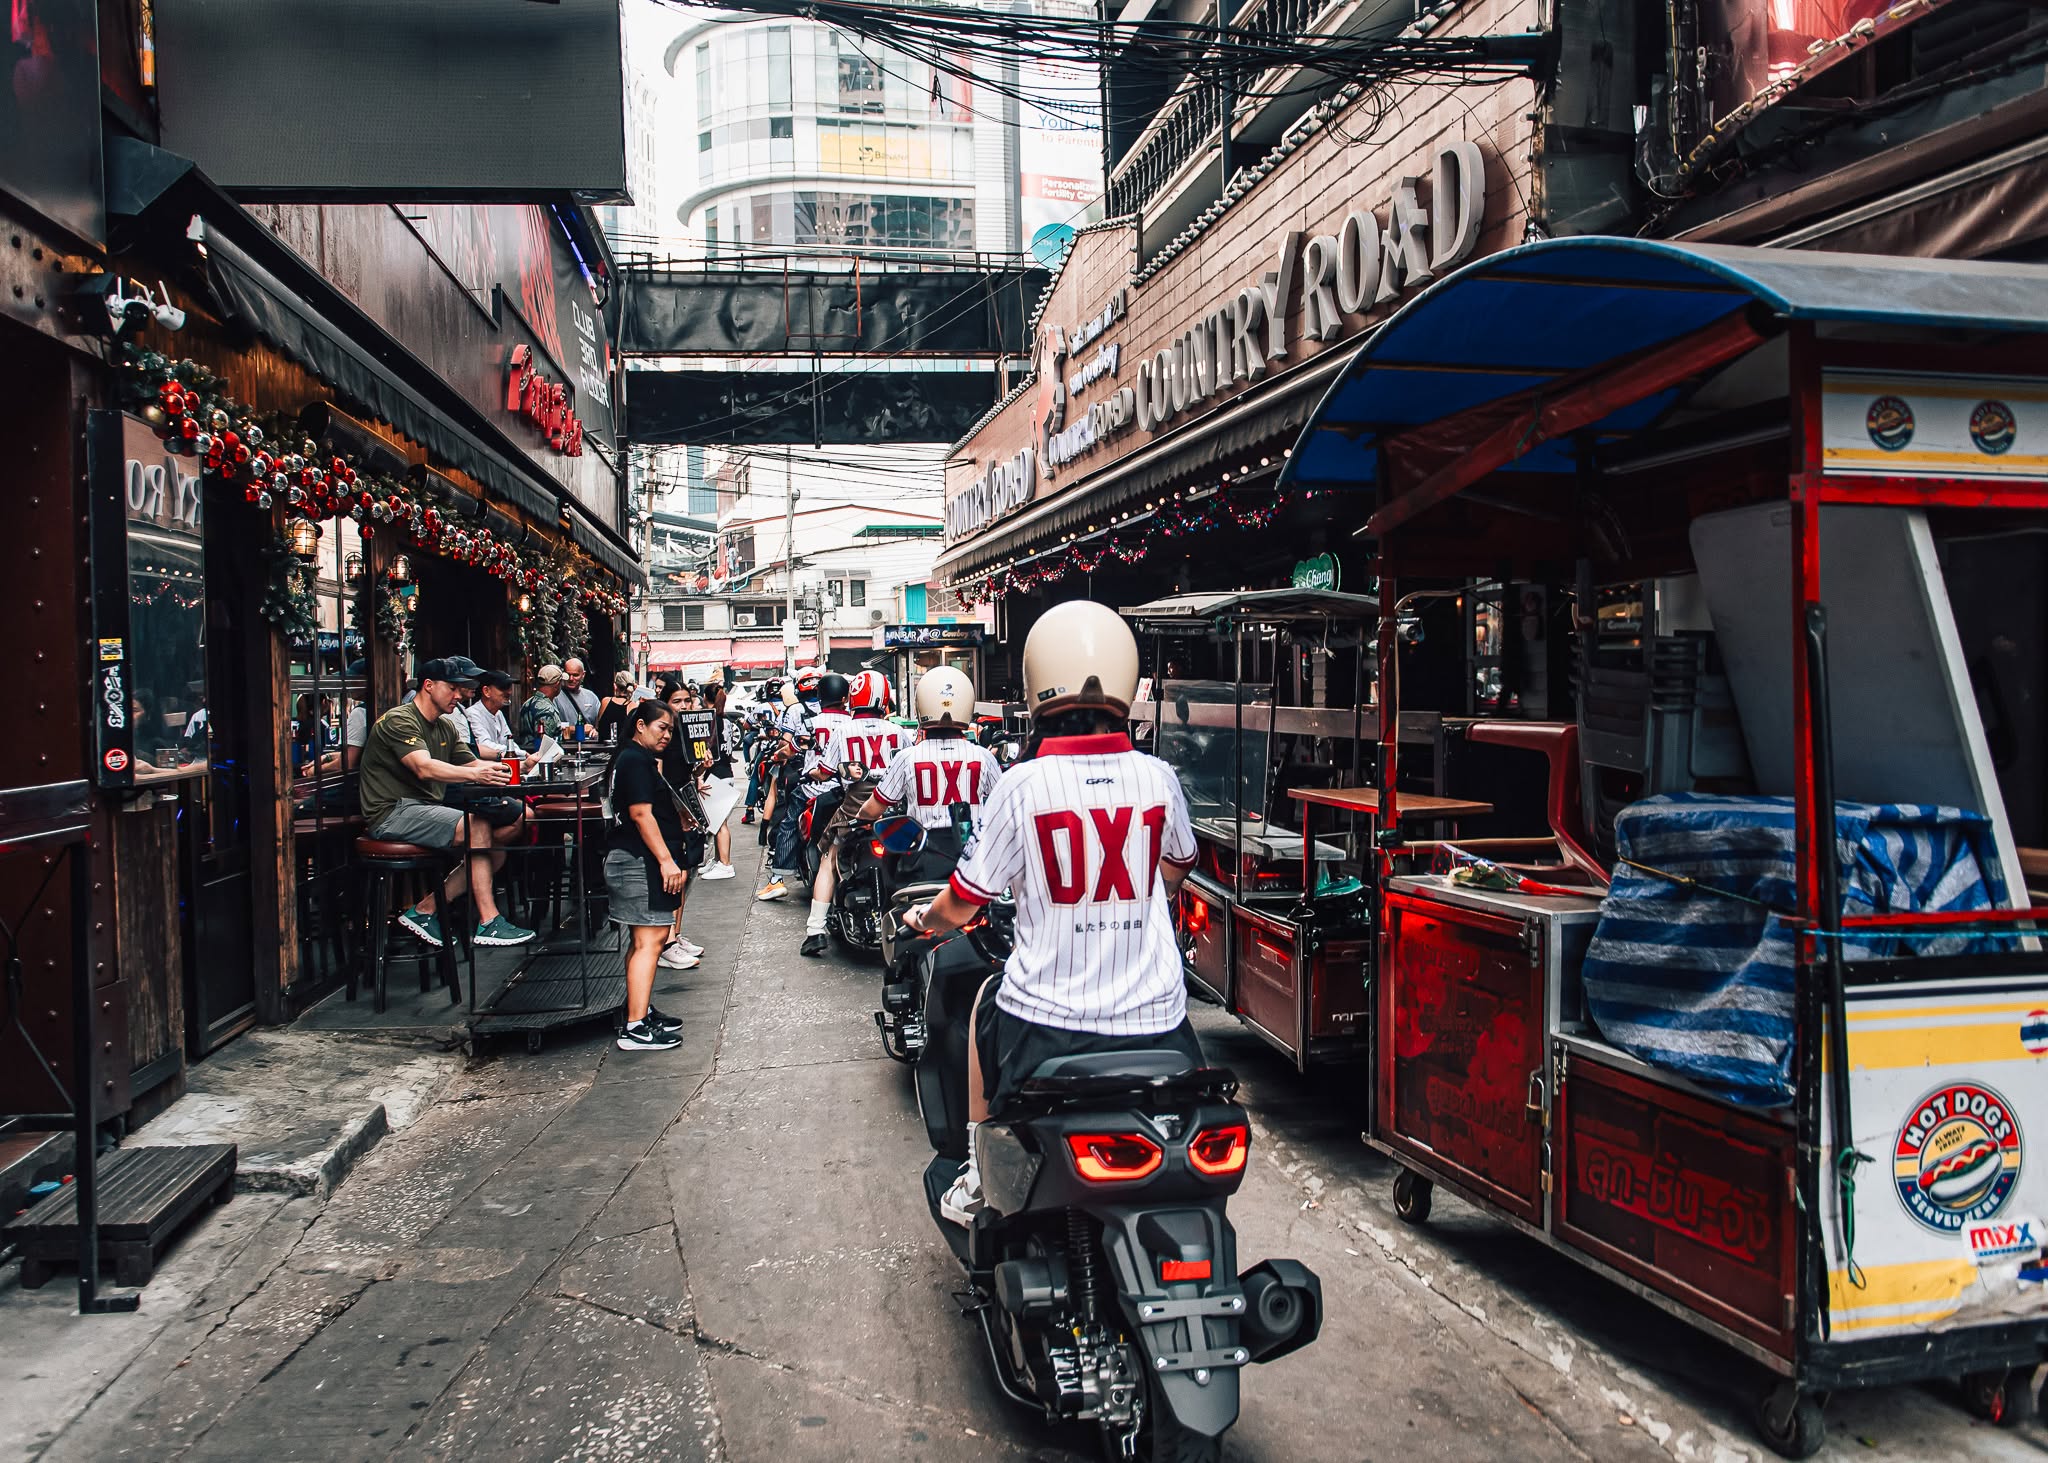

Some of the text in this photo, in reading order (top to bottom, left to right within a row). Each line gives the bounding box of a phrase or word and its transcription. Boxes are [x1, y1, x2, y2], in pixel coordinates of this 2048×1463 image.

[1042, 188, 1075, 202] Fertility
[1137, 141, 1485, 431] COUNTRY ROAD
[992, 448, 1035, 520] ROAD
[1306, 568, 1332, 588] Chang
[929, 629, 941, 640] @
[682, 713, 699, 724] HAPPY
[688, 723, 711, 739] BEER
[693, 741, 707, 759] 80
[914, 760, 982, 806] DX1
[1086, 777, 1115, 785] GPX
[1032, 803, 1167, 906] DX1
[1075, 919, 1143, 933] 私たちの自由
[1904, 1090, 2012, 1149] HOT DOGS
[1934, 1125, 1966, 1147] ALWAYS
[1911, 1192, 1961, 1227] SERVED
